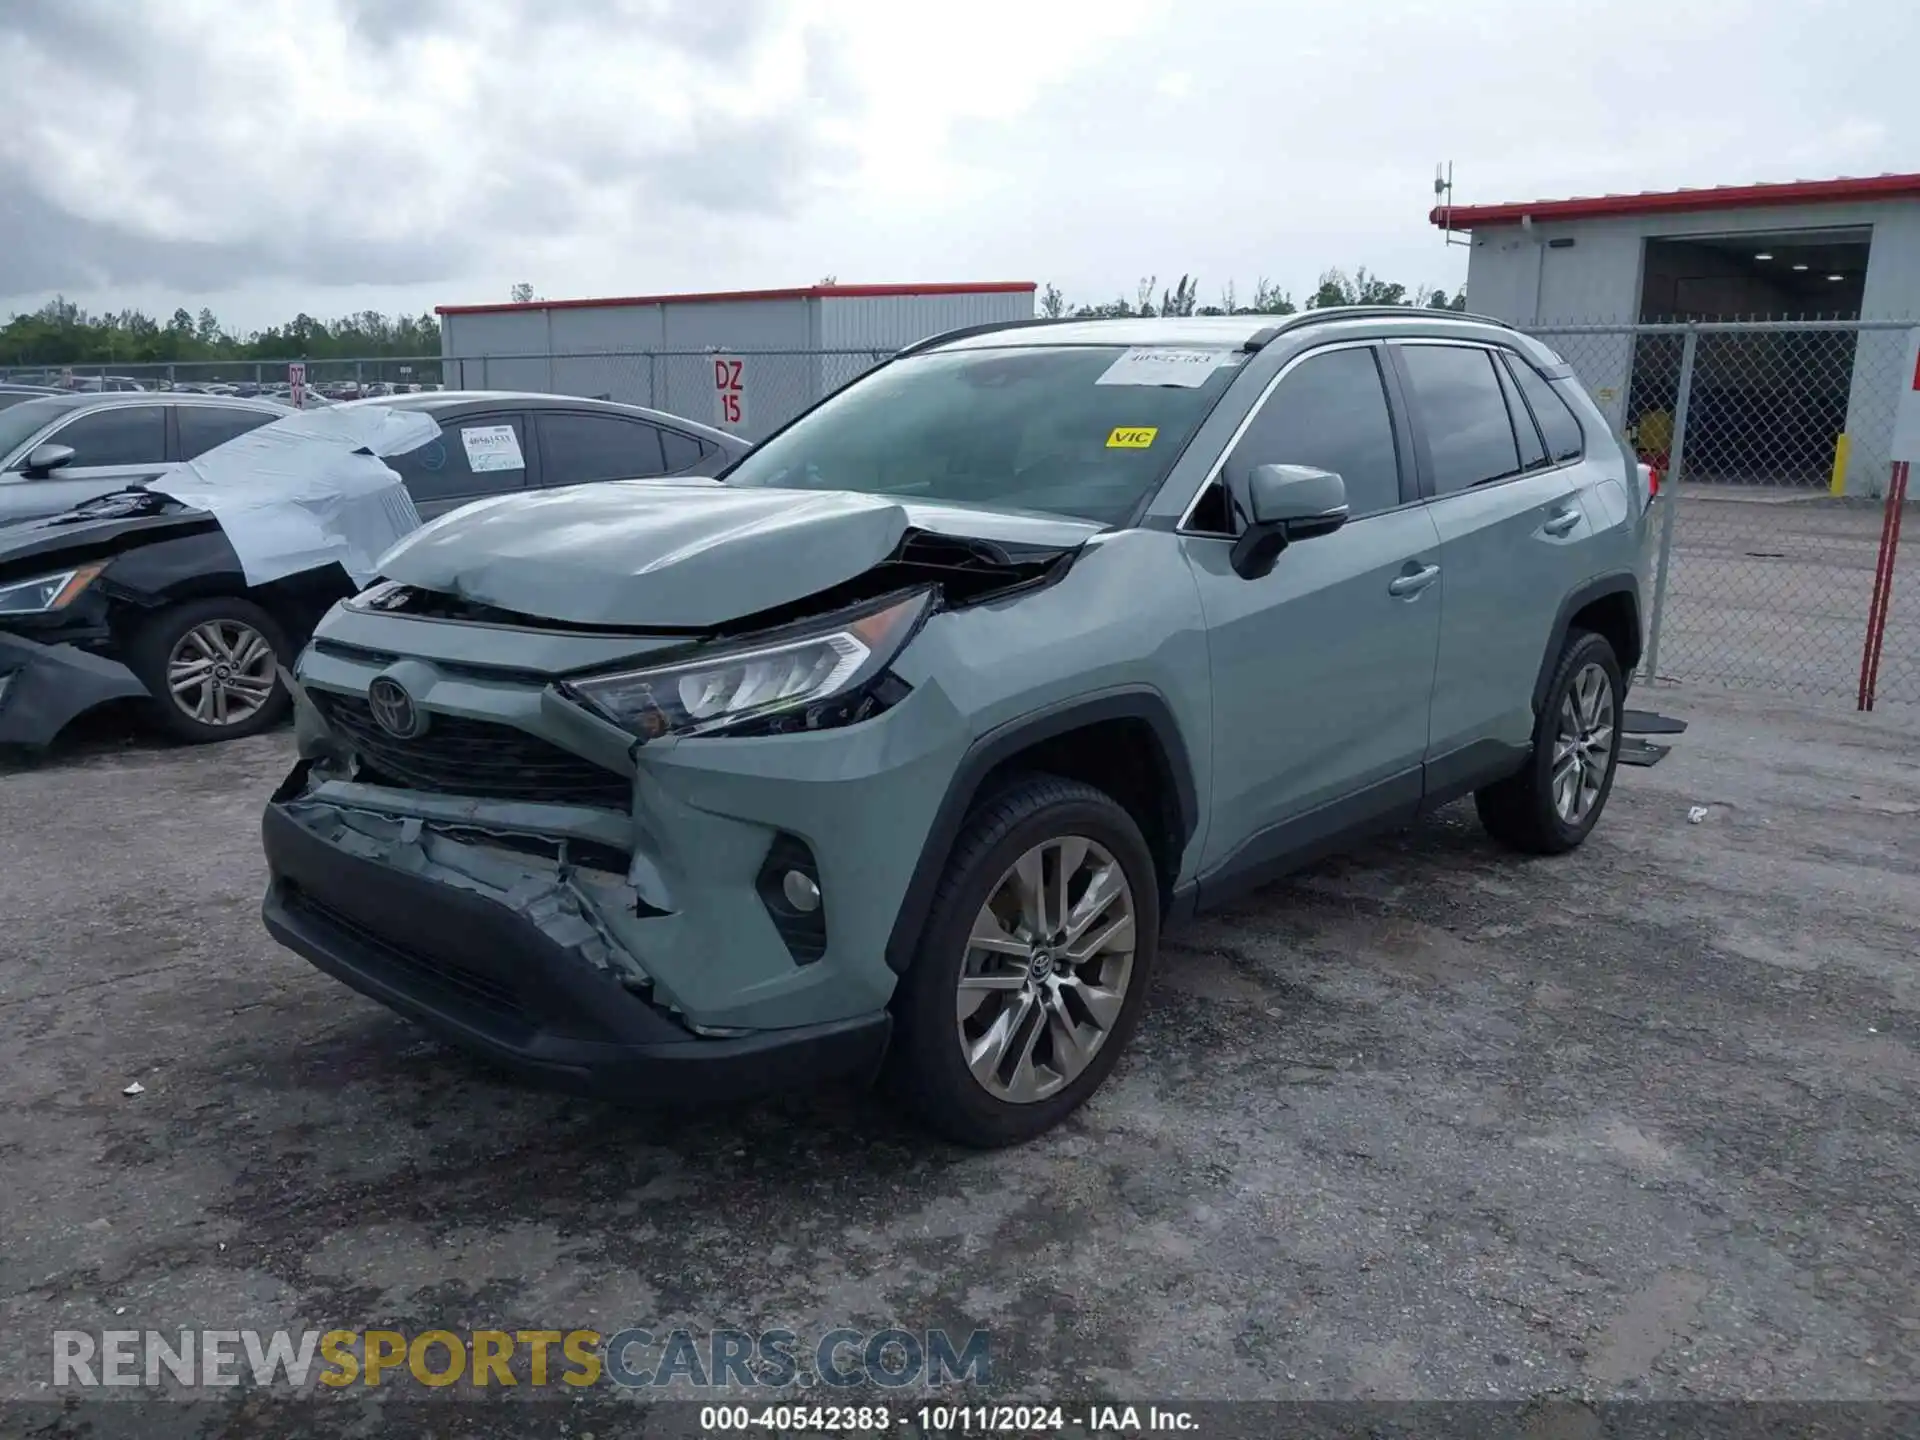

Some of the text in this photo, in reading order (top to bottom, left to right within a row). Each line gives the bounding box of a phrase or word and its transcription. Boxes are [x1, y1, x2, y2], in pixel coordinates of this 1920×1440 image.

[291, 367, 304, 387] DZ
[715, 360, 744, 391] DZ
[721, 394, 741, 423] 15
[1115, 431, 1152, 443] VIC
